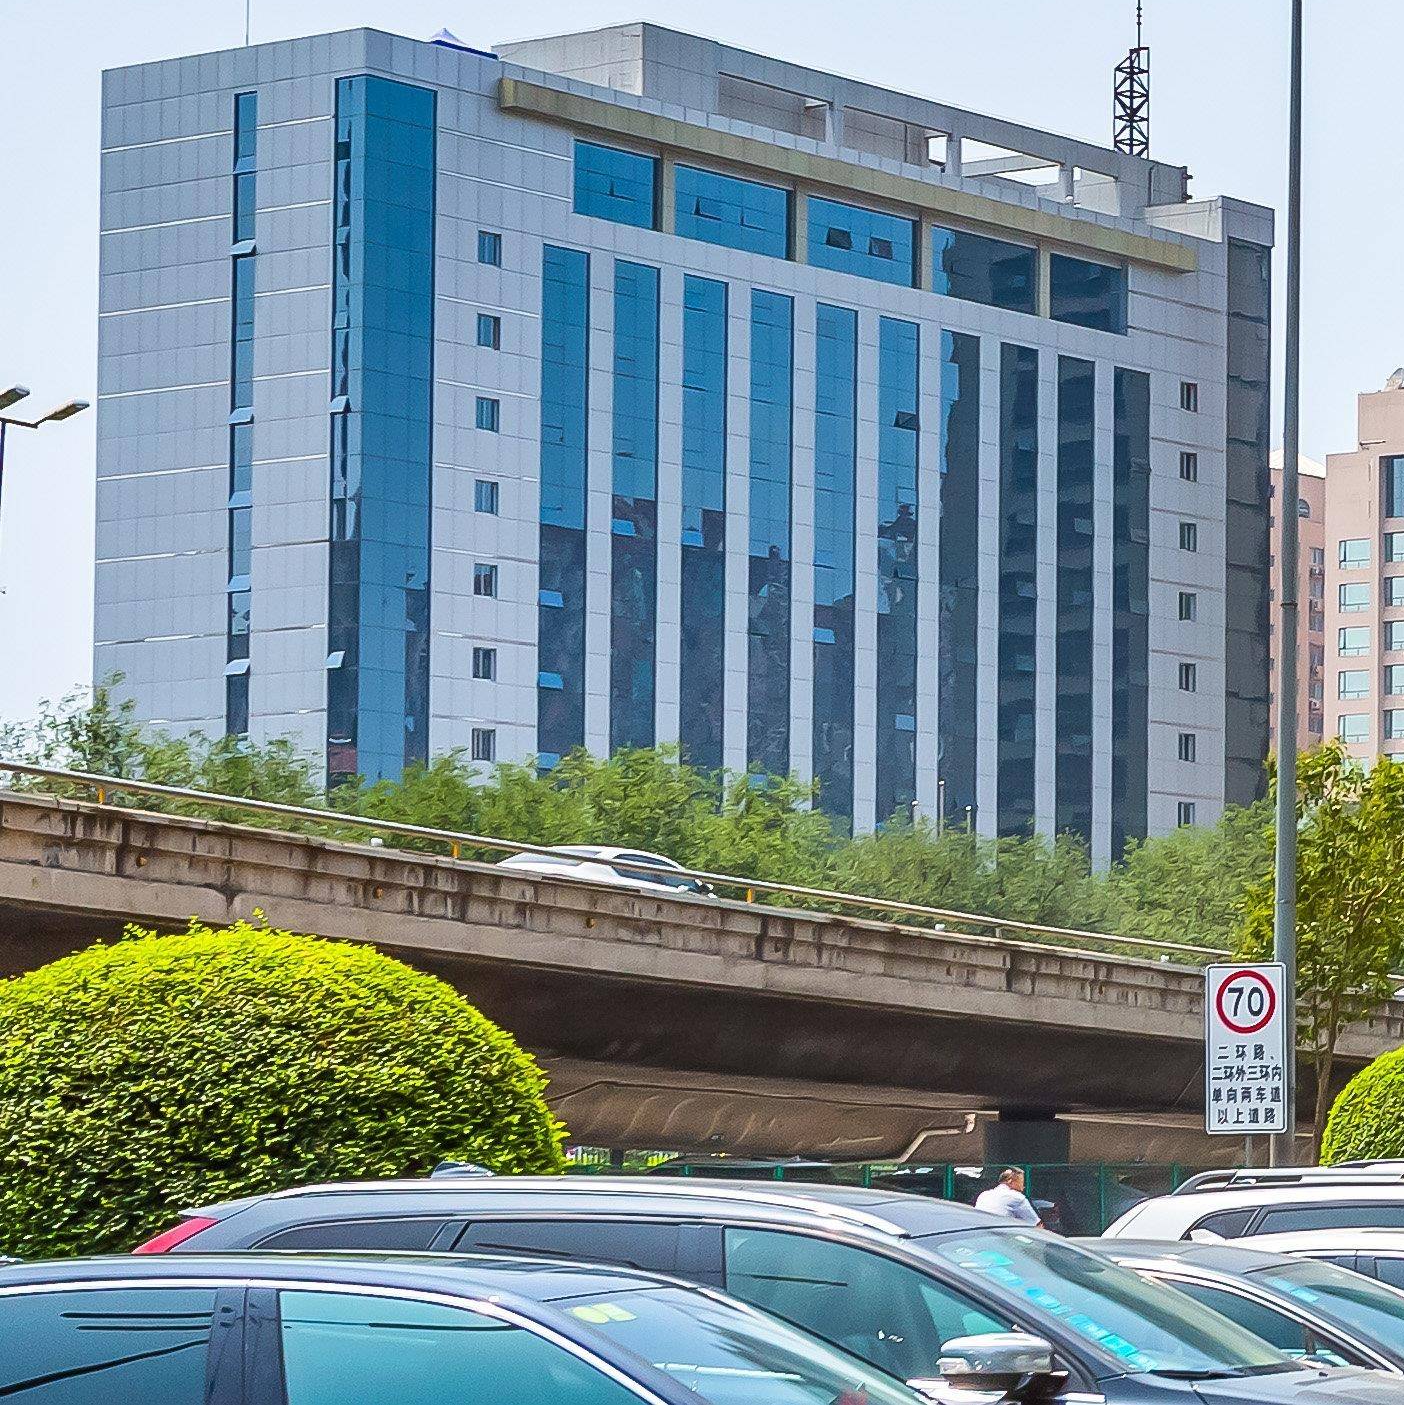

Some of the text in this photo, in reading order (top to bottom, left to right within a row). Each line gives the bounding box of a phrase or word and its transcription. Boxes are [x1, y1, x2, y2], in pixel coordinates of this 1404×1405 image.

[1227, 986, 1265, 1017] 70
[1211, 1064, 1282, 1082] 二环外三环内
[1211, 1086, 1282, 1104] 单向两车道
[1217, 1107, 1276, 1124] 以上道路
